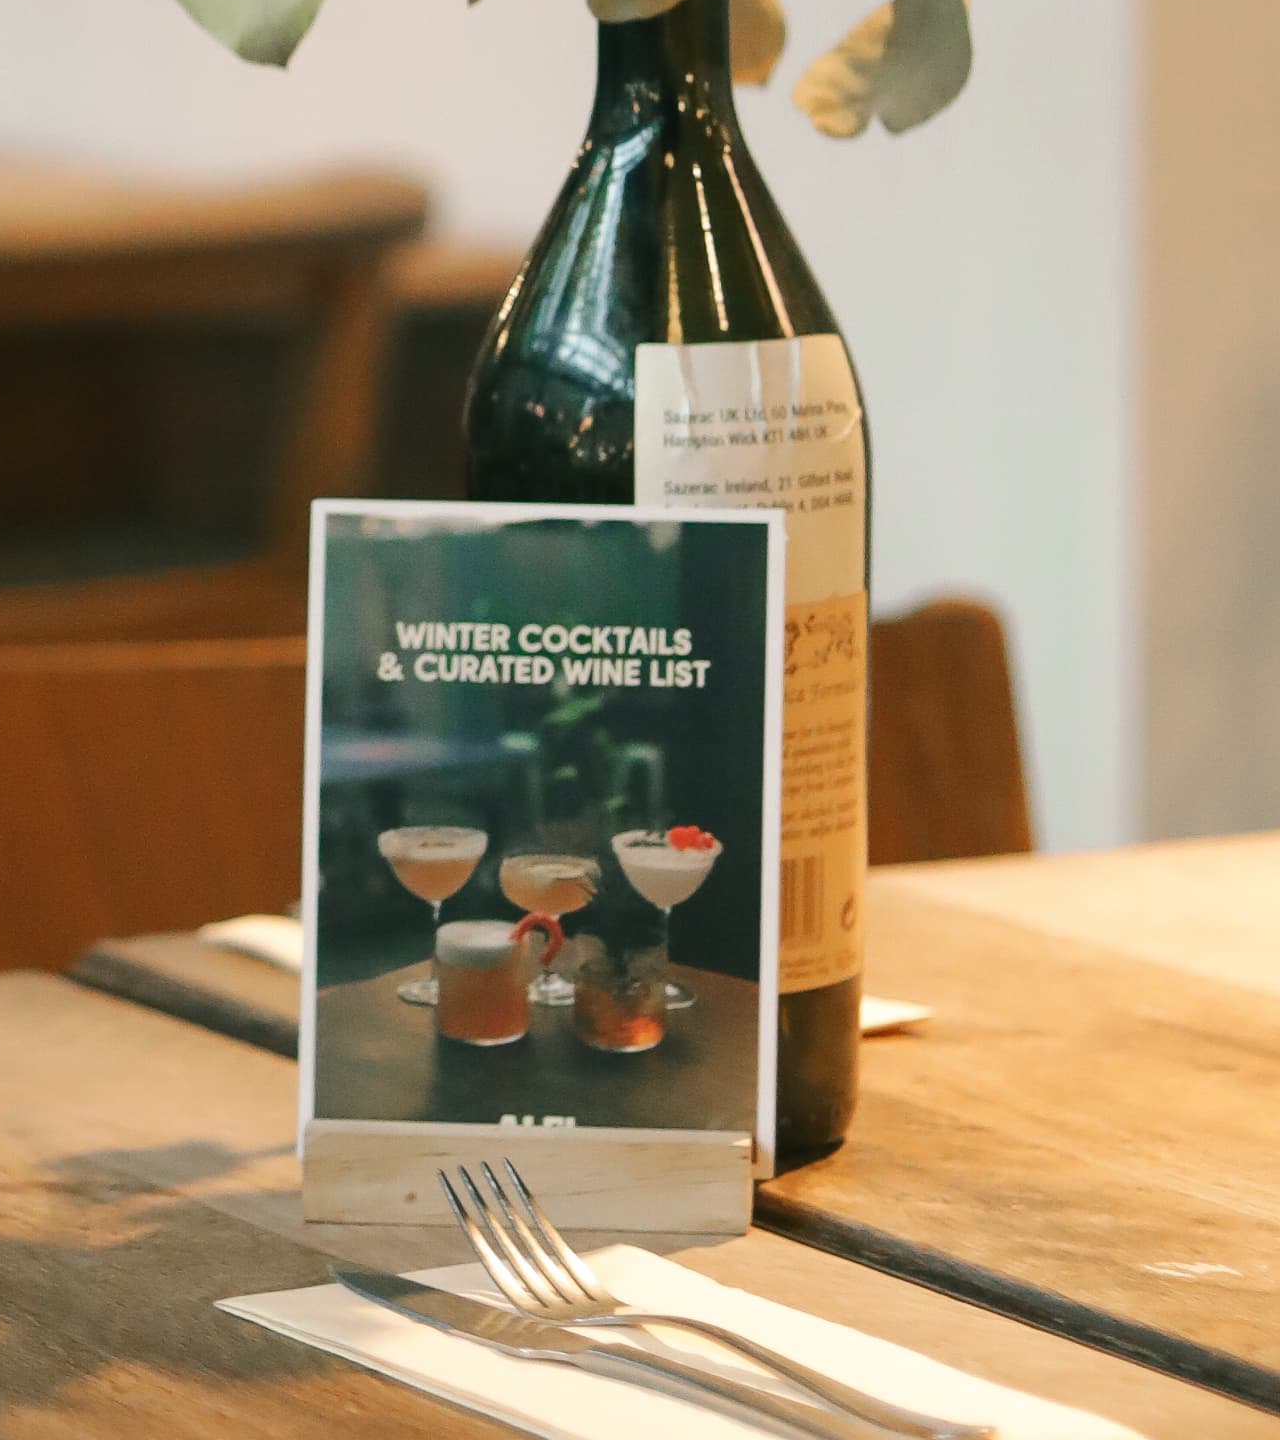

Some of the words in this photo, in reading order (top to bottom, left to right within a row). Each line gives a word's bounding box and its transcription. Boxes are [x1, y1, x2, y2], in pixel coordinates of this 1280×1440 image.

[664, 480, 717, 495] Sazerac
[396, 621, 511, 652] WINTER
[518, 623, 692, 656] COCKTAILS
[377, 651, 404, 682] &
[413, 652, 554, 685] CURATED
[561, 656, 641, 687] WINE
[649, 658, 711, 689] LIST
